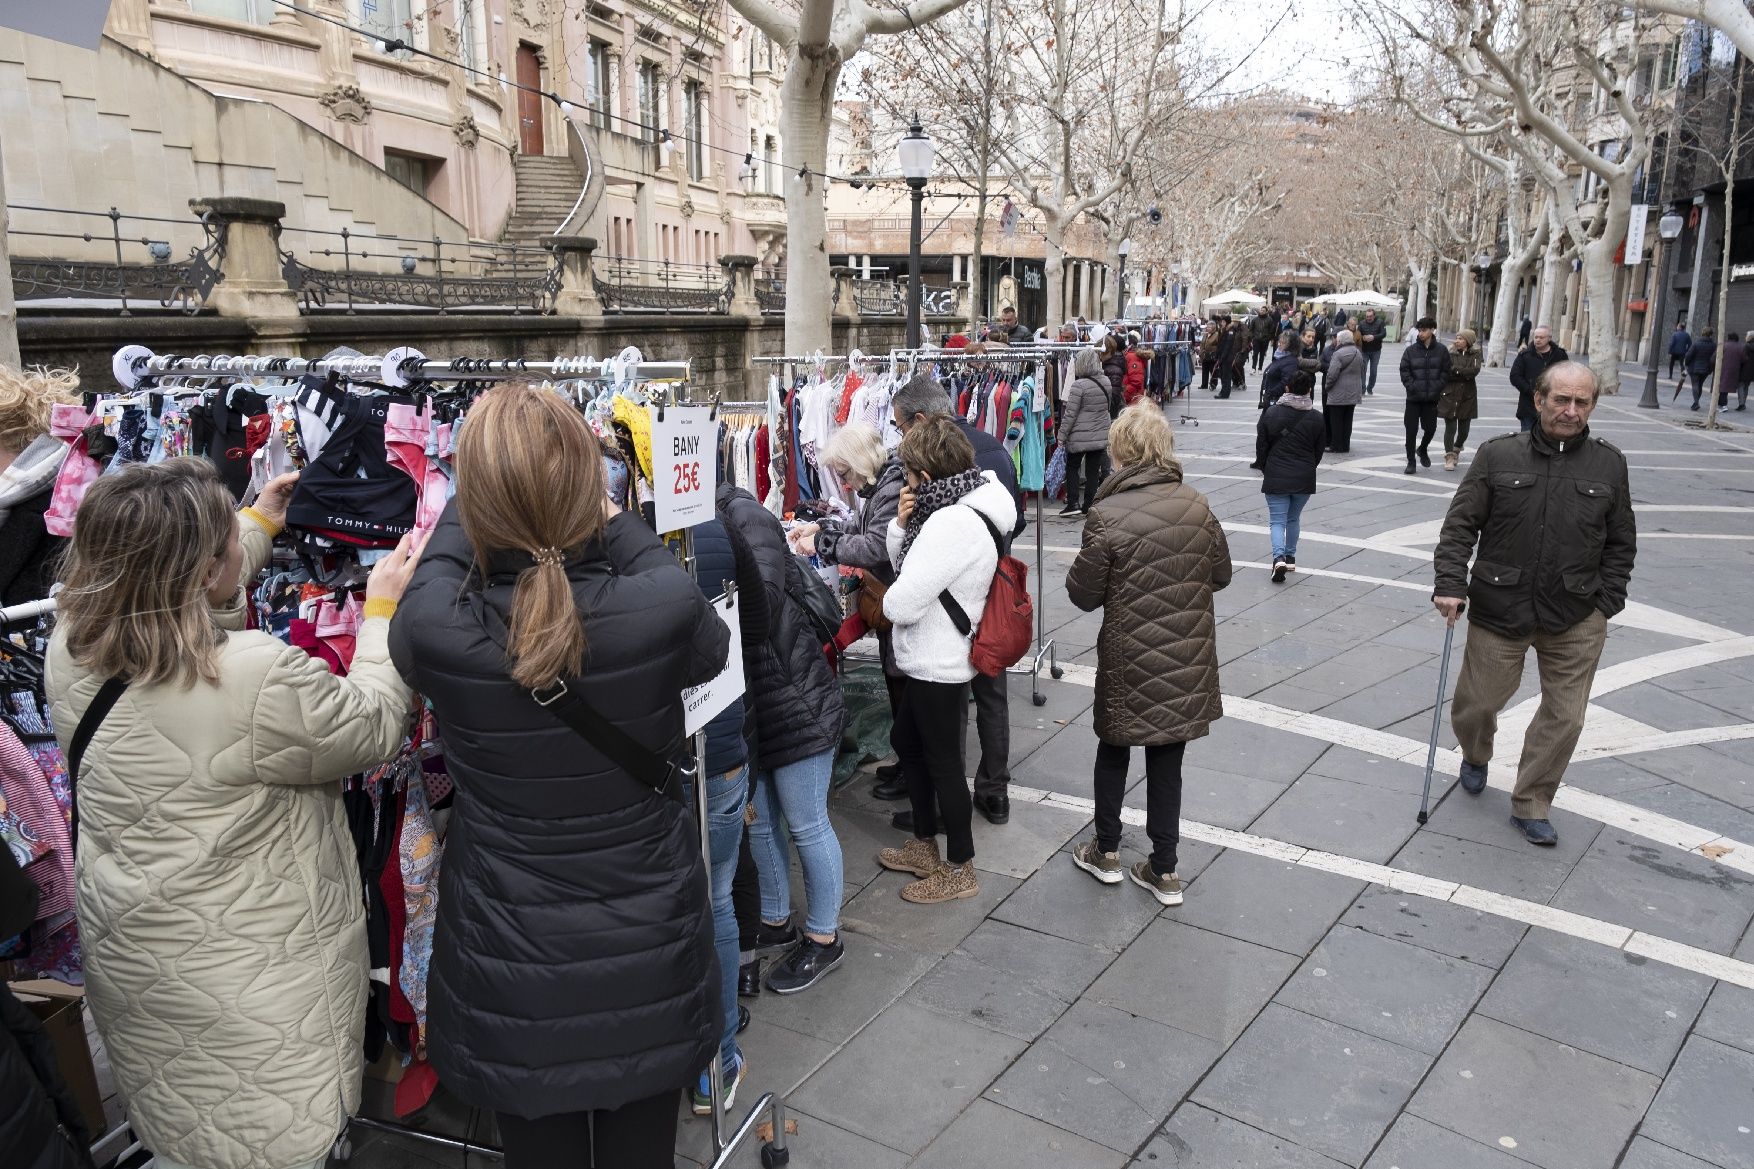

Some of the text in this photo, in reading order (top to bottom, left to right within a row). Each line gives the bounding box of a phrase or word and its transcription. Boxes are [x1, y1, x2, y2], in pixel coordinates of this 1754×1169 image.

[673, 436, 700, 457] BANY
[673, 462, 700, 494] 25€
[327, 516, 411, 535] TOMMY HILF
